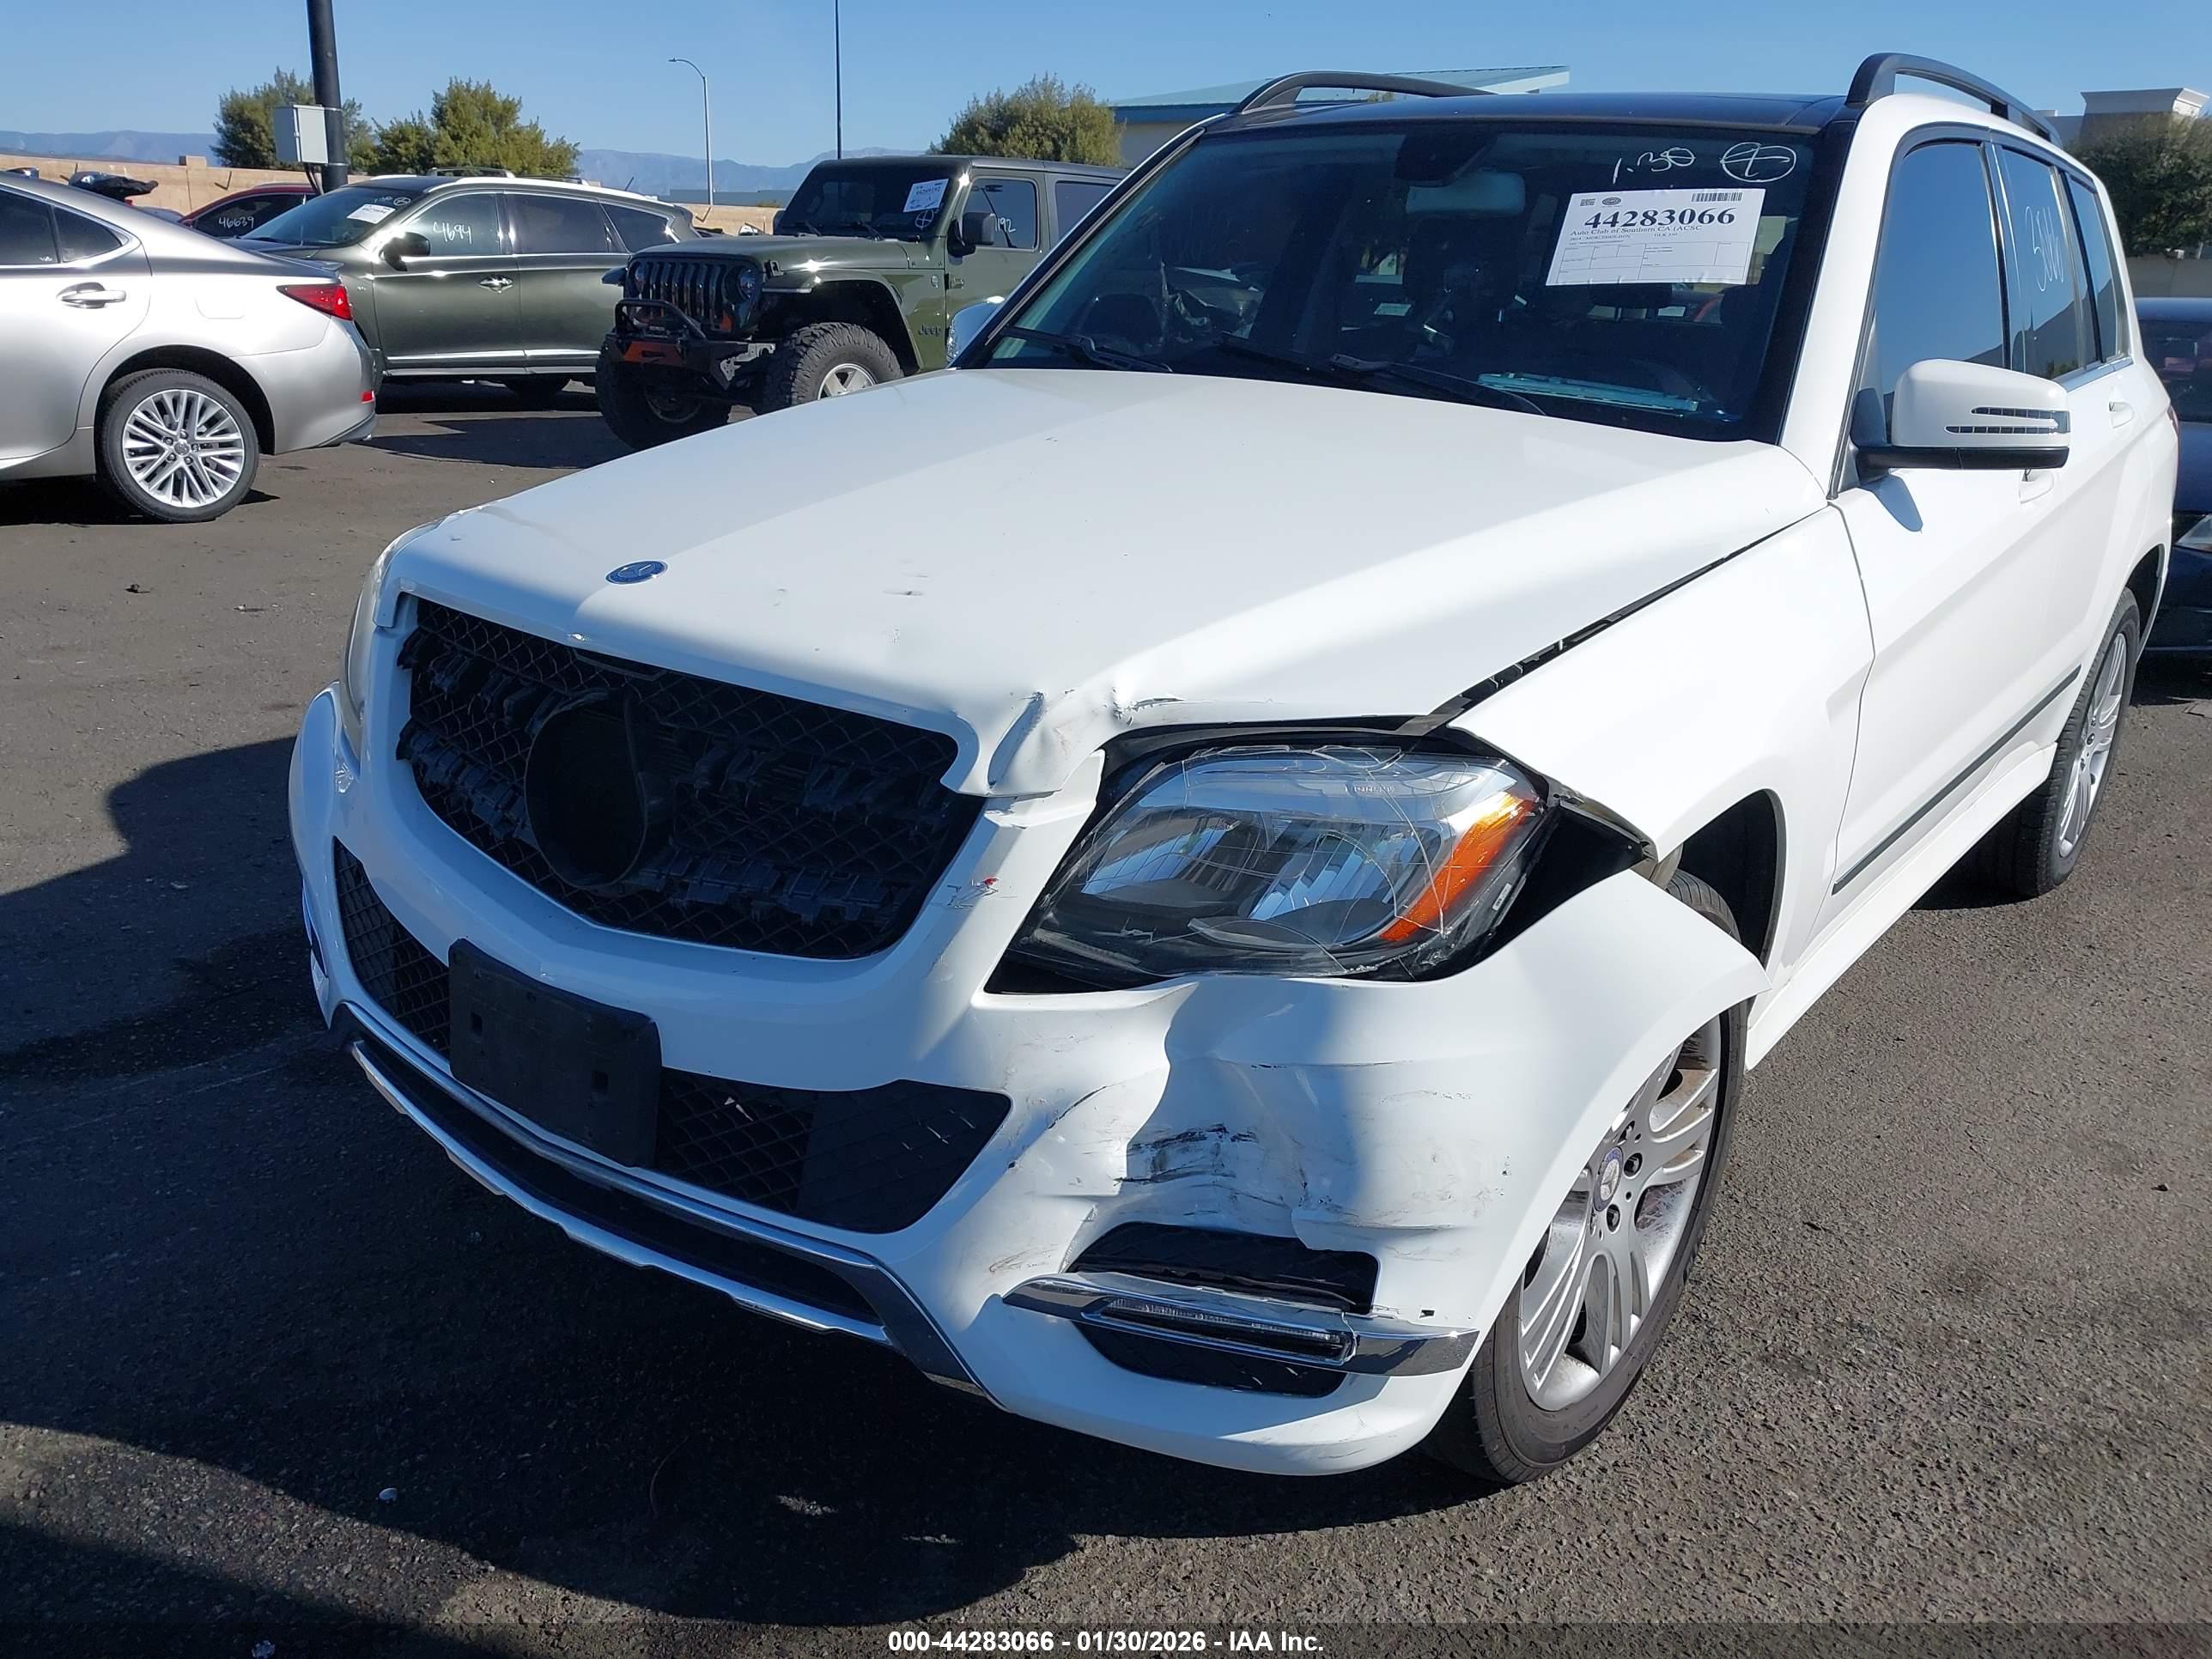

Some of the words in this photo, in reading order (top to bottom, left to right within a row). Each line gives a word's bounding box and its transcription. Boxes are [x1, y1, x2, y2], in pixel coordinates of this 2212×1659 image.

[218, 216, 254, 229] 46639
[1584, 207, 1737, 228] 44283066
[432, 221, 472, 245] 4694
[918, 324, 941, 337] Jeep
